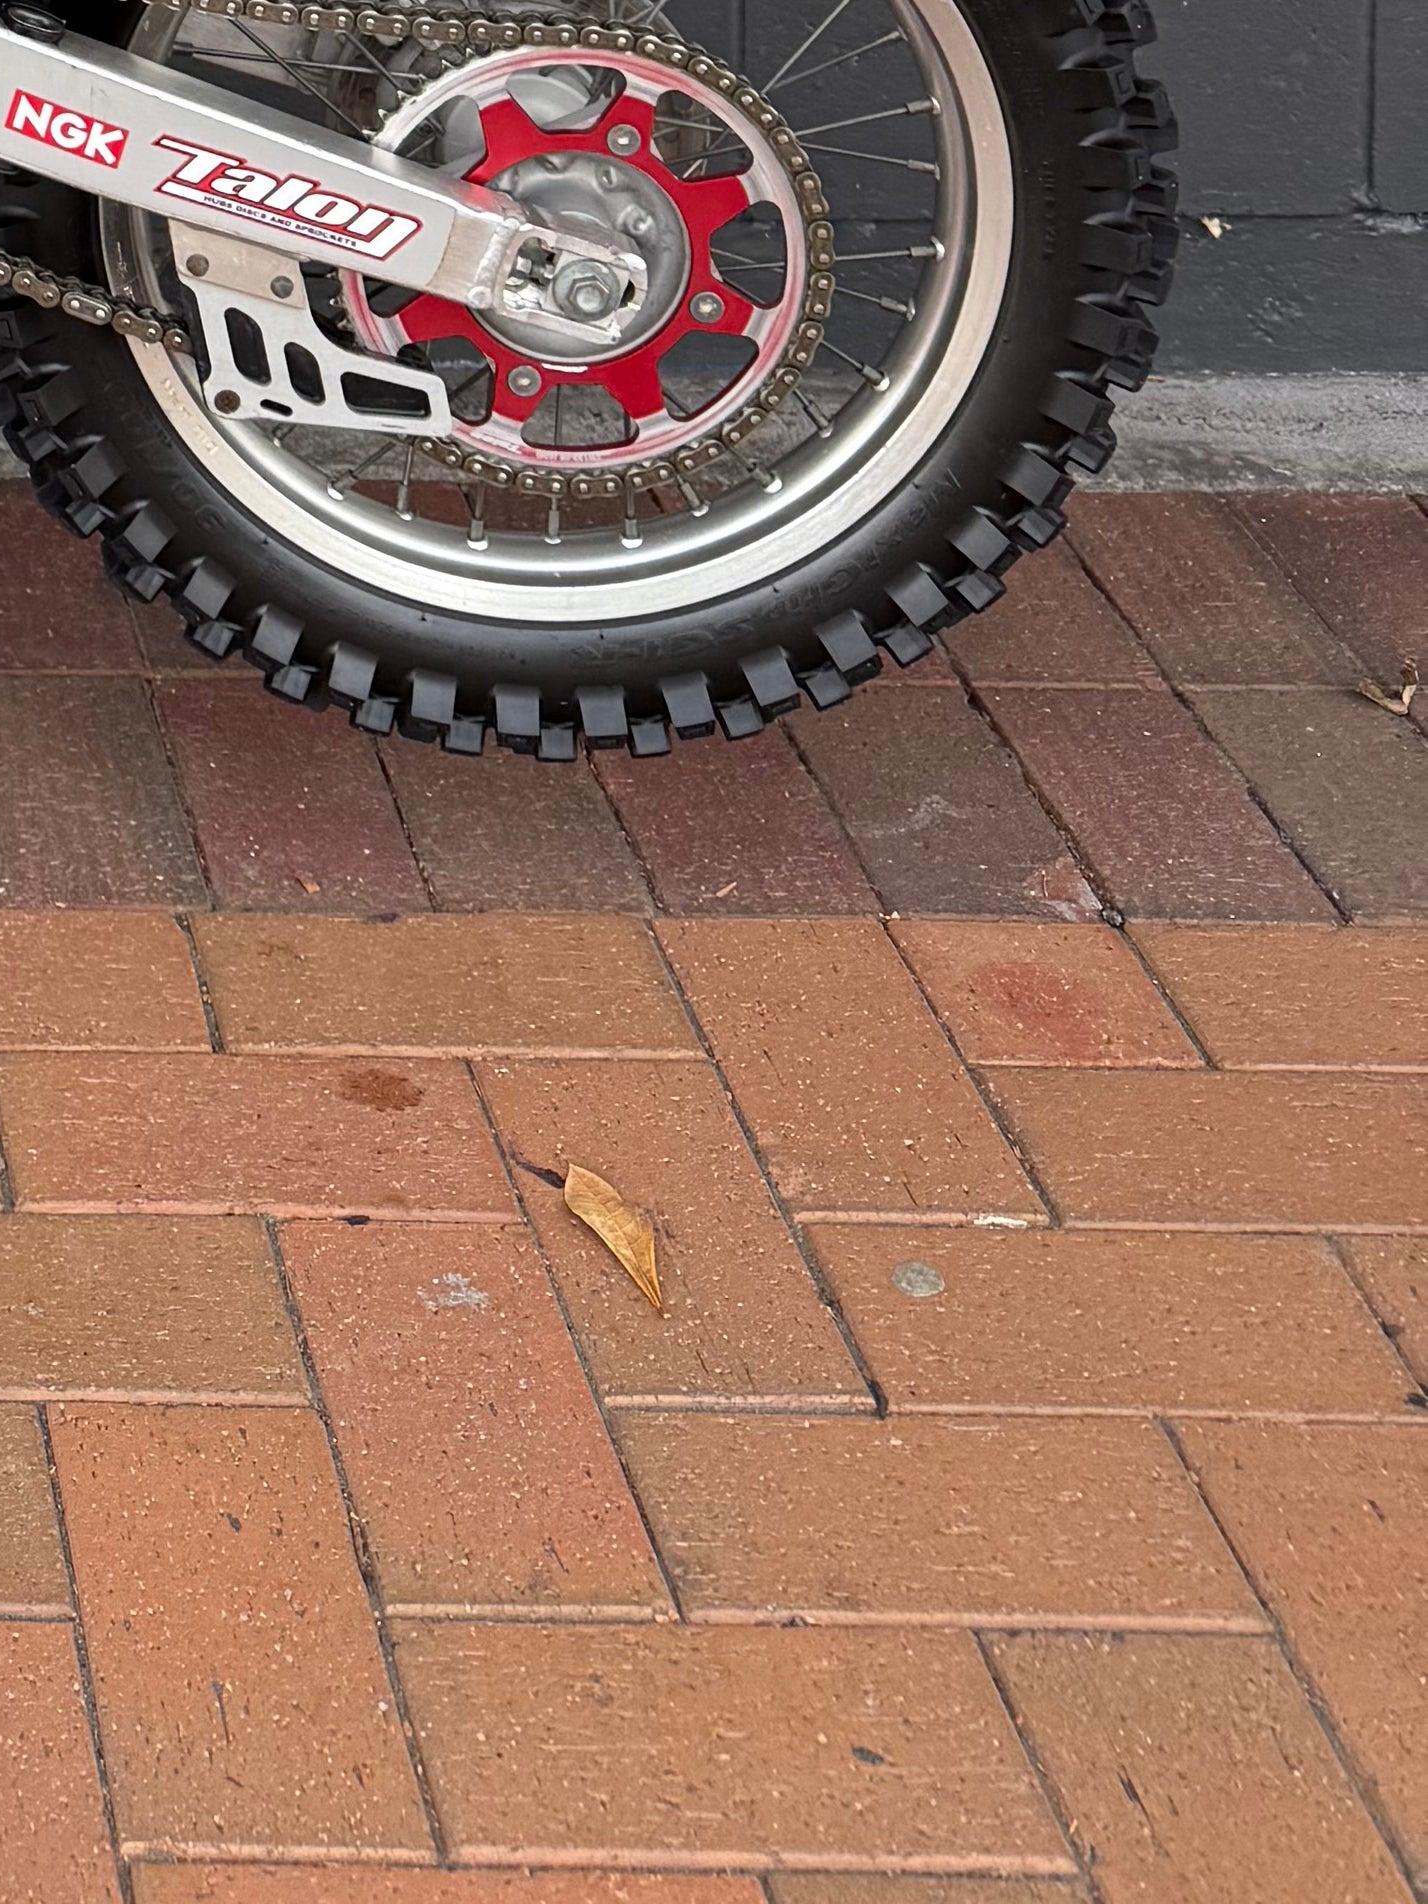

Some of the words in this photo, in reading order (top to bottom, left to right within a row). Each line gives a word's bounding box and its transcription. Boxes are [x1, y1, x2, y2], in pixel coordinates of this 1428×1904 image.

[12, 94, 125, 165] NGK
[154, 135, 423, 258] Talon
[204, 195, 233, 210] HUBS
[236, 204, 267, 220] DISCS
[270, 215, 292, 228] AND
[295, 223, 357, 248] SPROCKETS
